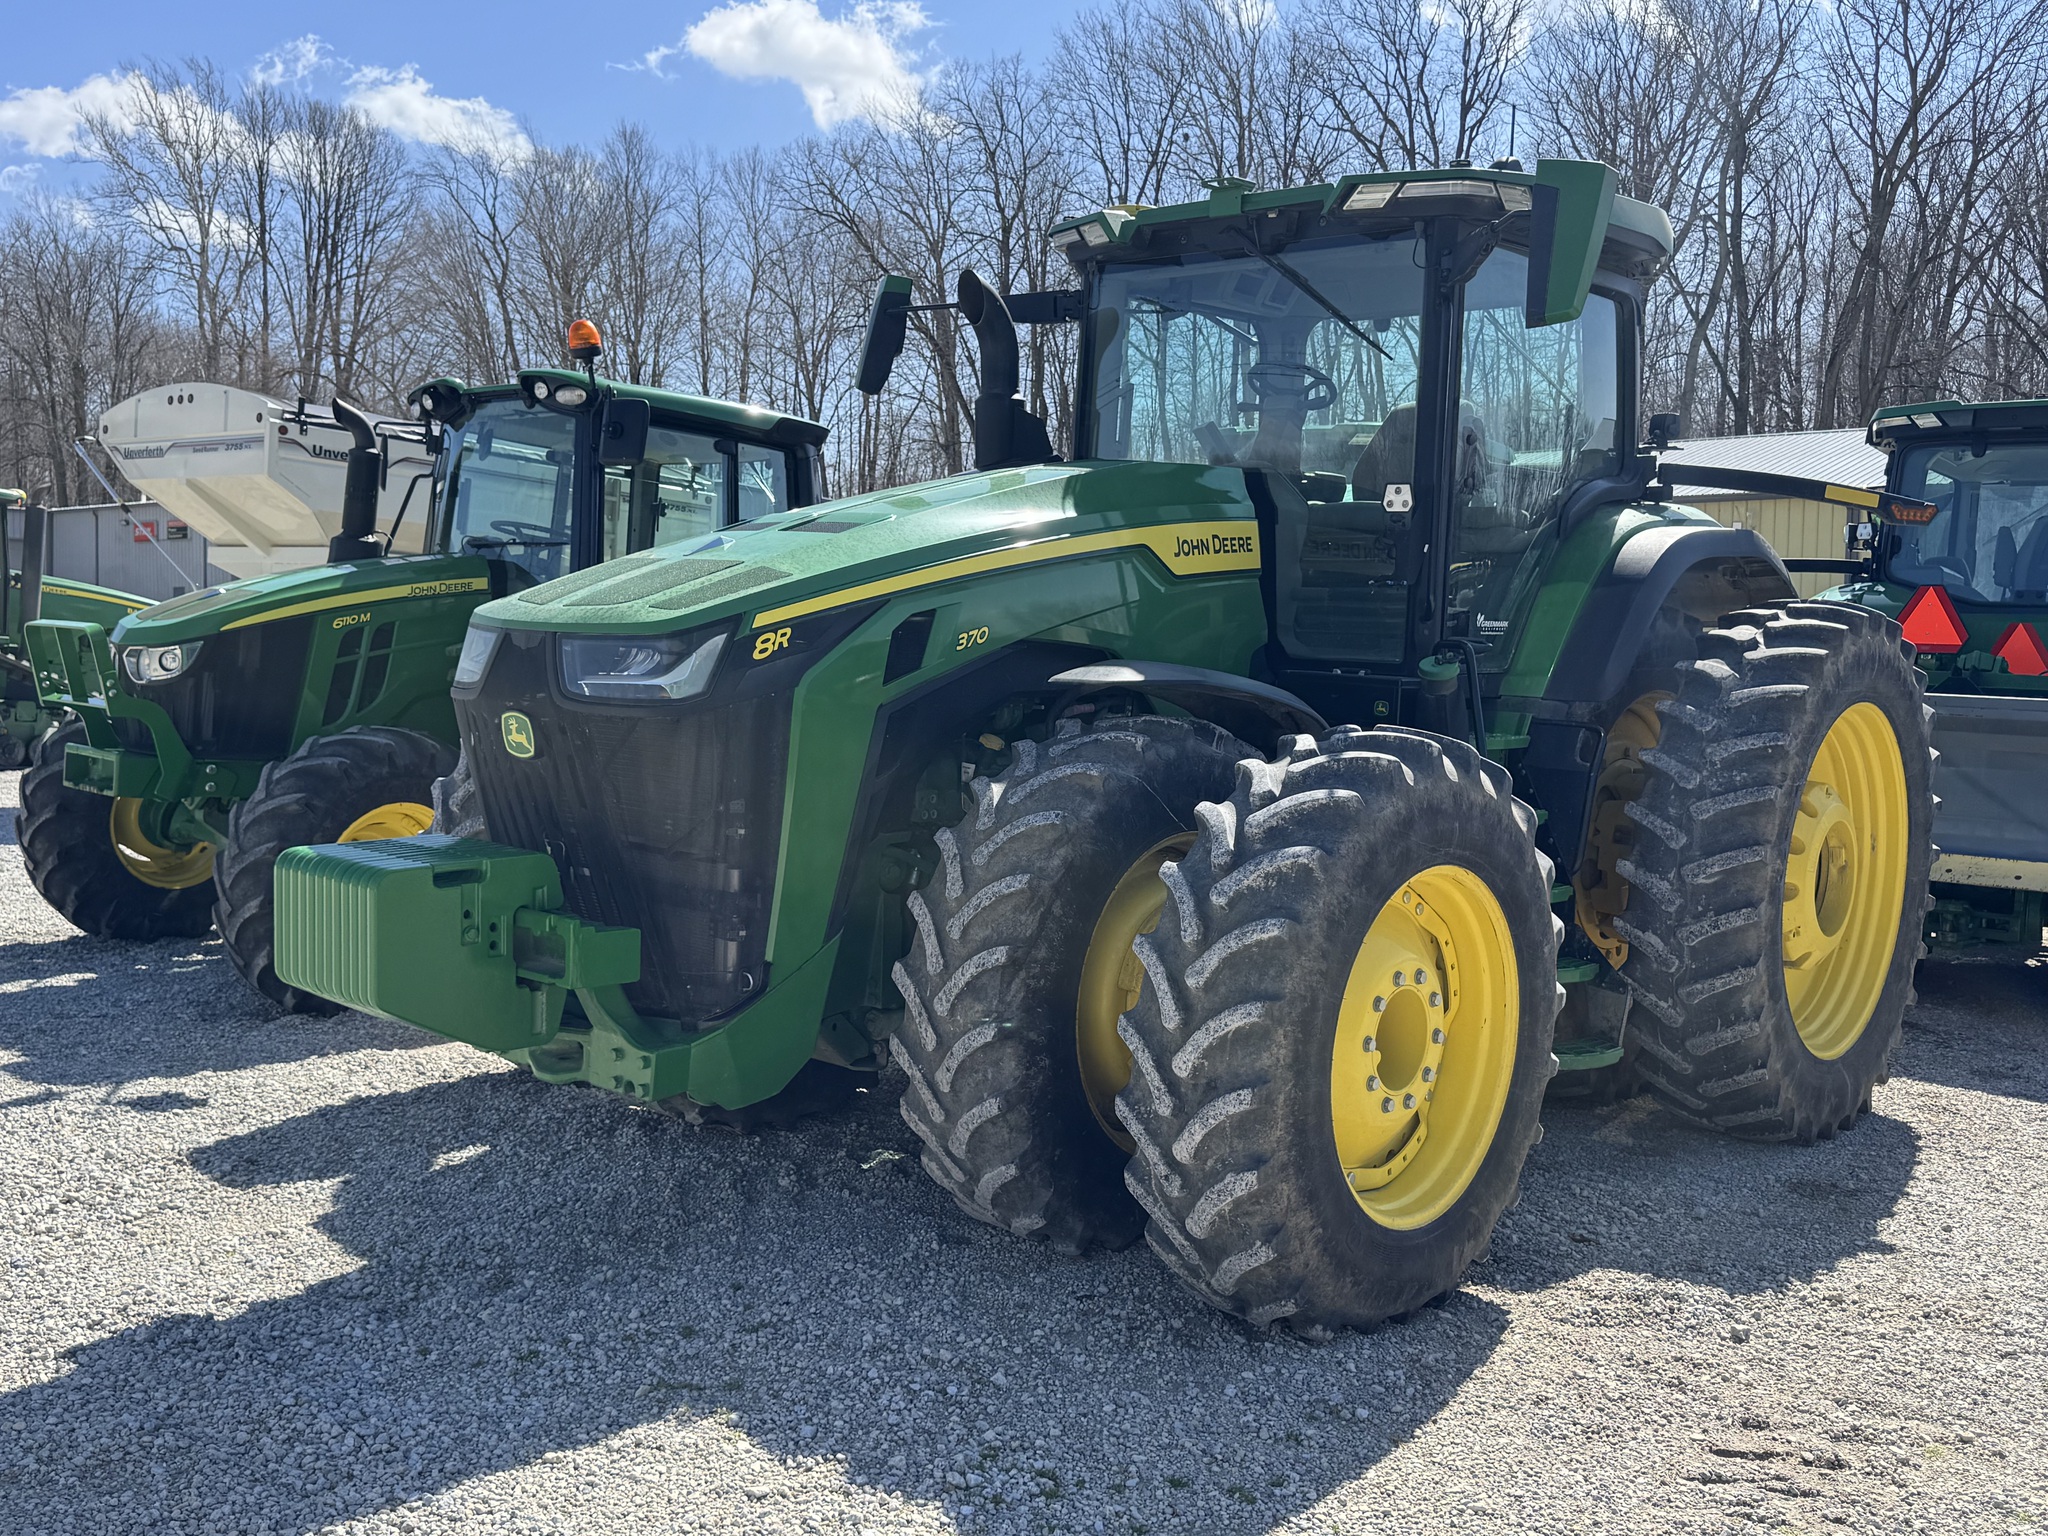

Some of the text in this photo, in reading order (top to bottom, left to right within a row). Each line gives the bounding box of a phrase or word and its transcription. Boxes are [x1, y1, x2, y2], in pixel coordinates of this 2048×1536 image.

[123, 445, 164, 459] Unverferth
[224, 442, 244, 452] 3755
[312, 444, 349, 460] Unve
[1174, 534, 1253, 557] JOHN DEERE
[407, 581, 474, 597] JOHN DEERE
[332, 612, 371, 629] 6110 M
[752, 627, 792, 660] 8R
[955, 626, 989, 651] 370
